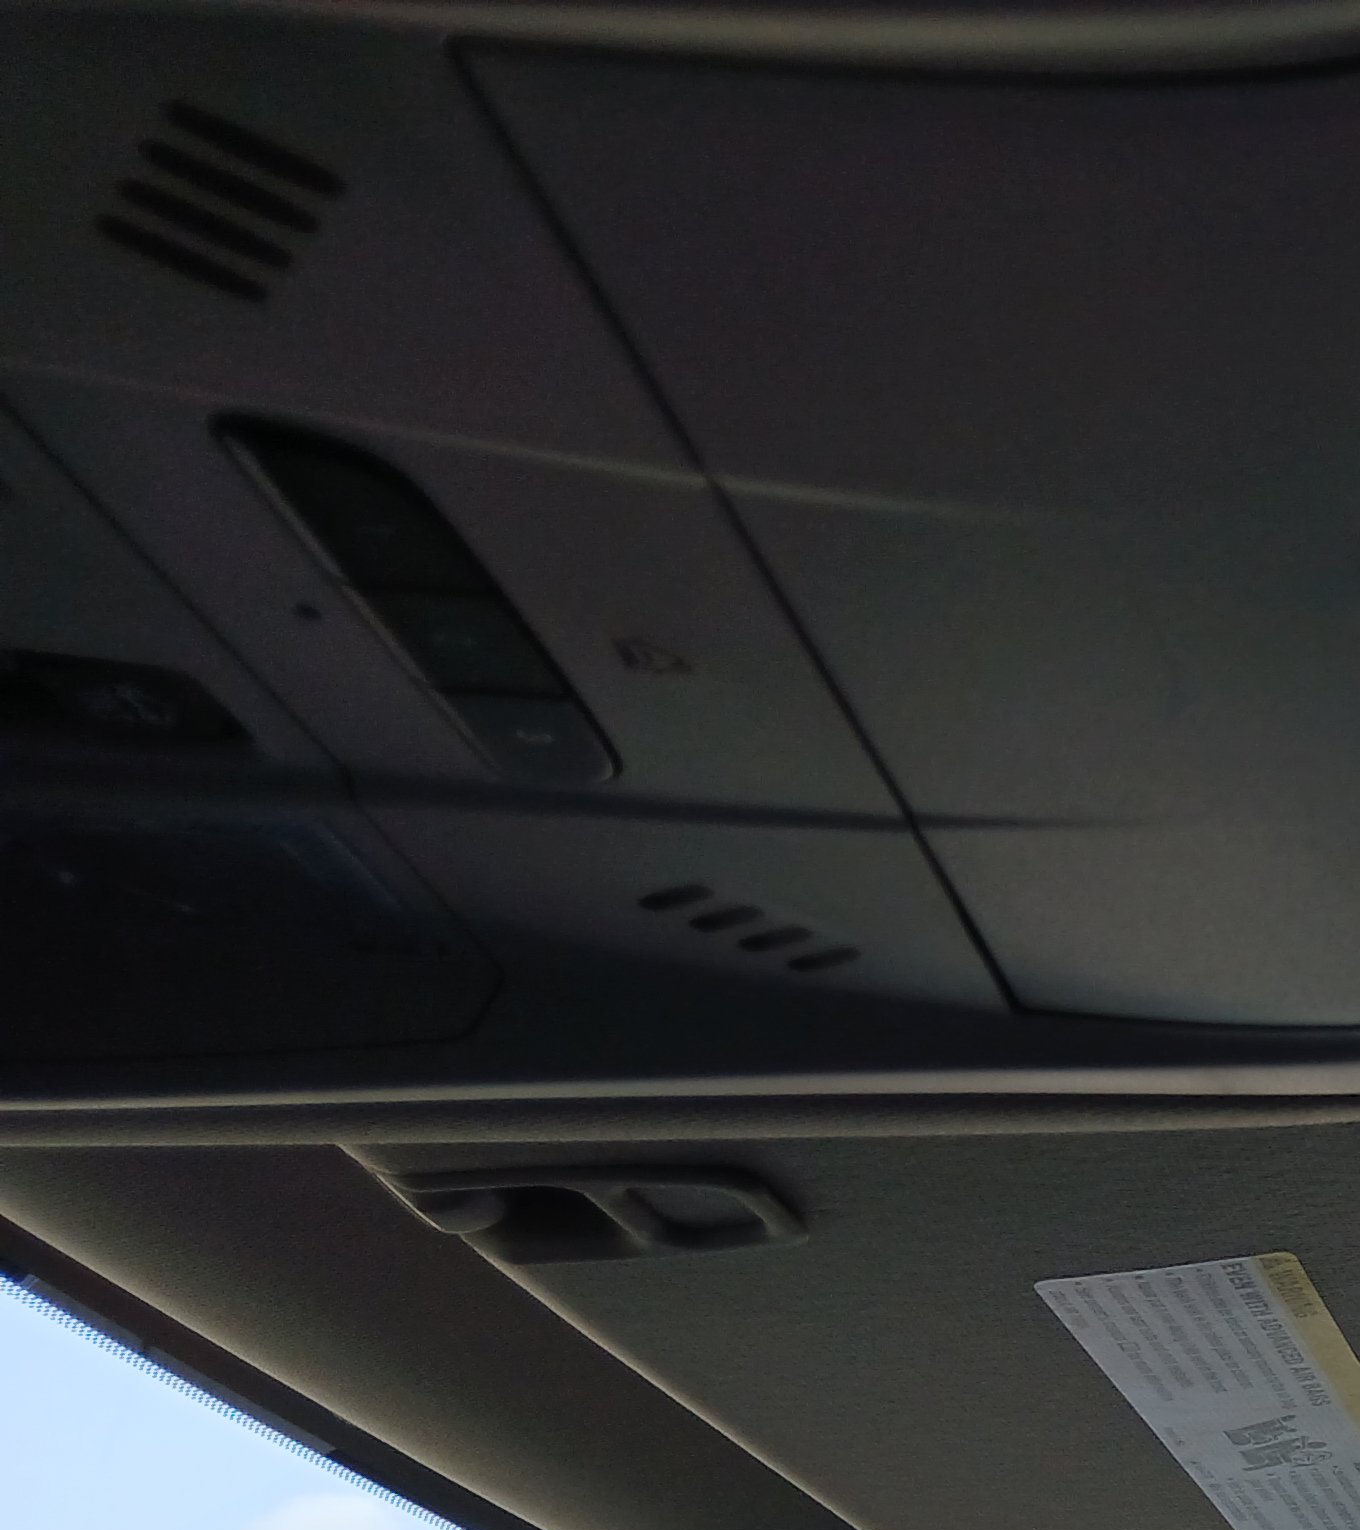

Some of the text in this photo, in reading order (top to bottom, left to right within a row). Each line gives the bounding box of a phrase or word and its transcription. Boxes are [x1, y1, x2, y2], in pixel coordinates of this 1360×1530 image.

[1219, 1262, 1333, 1407] EVEN WITH ADVANCED AIR BAGS
